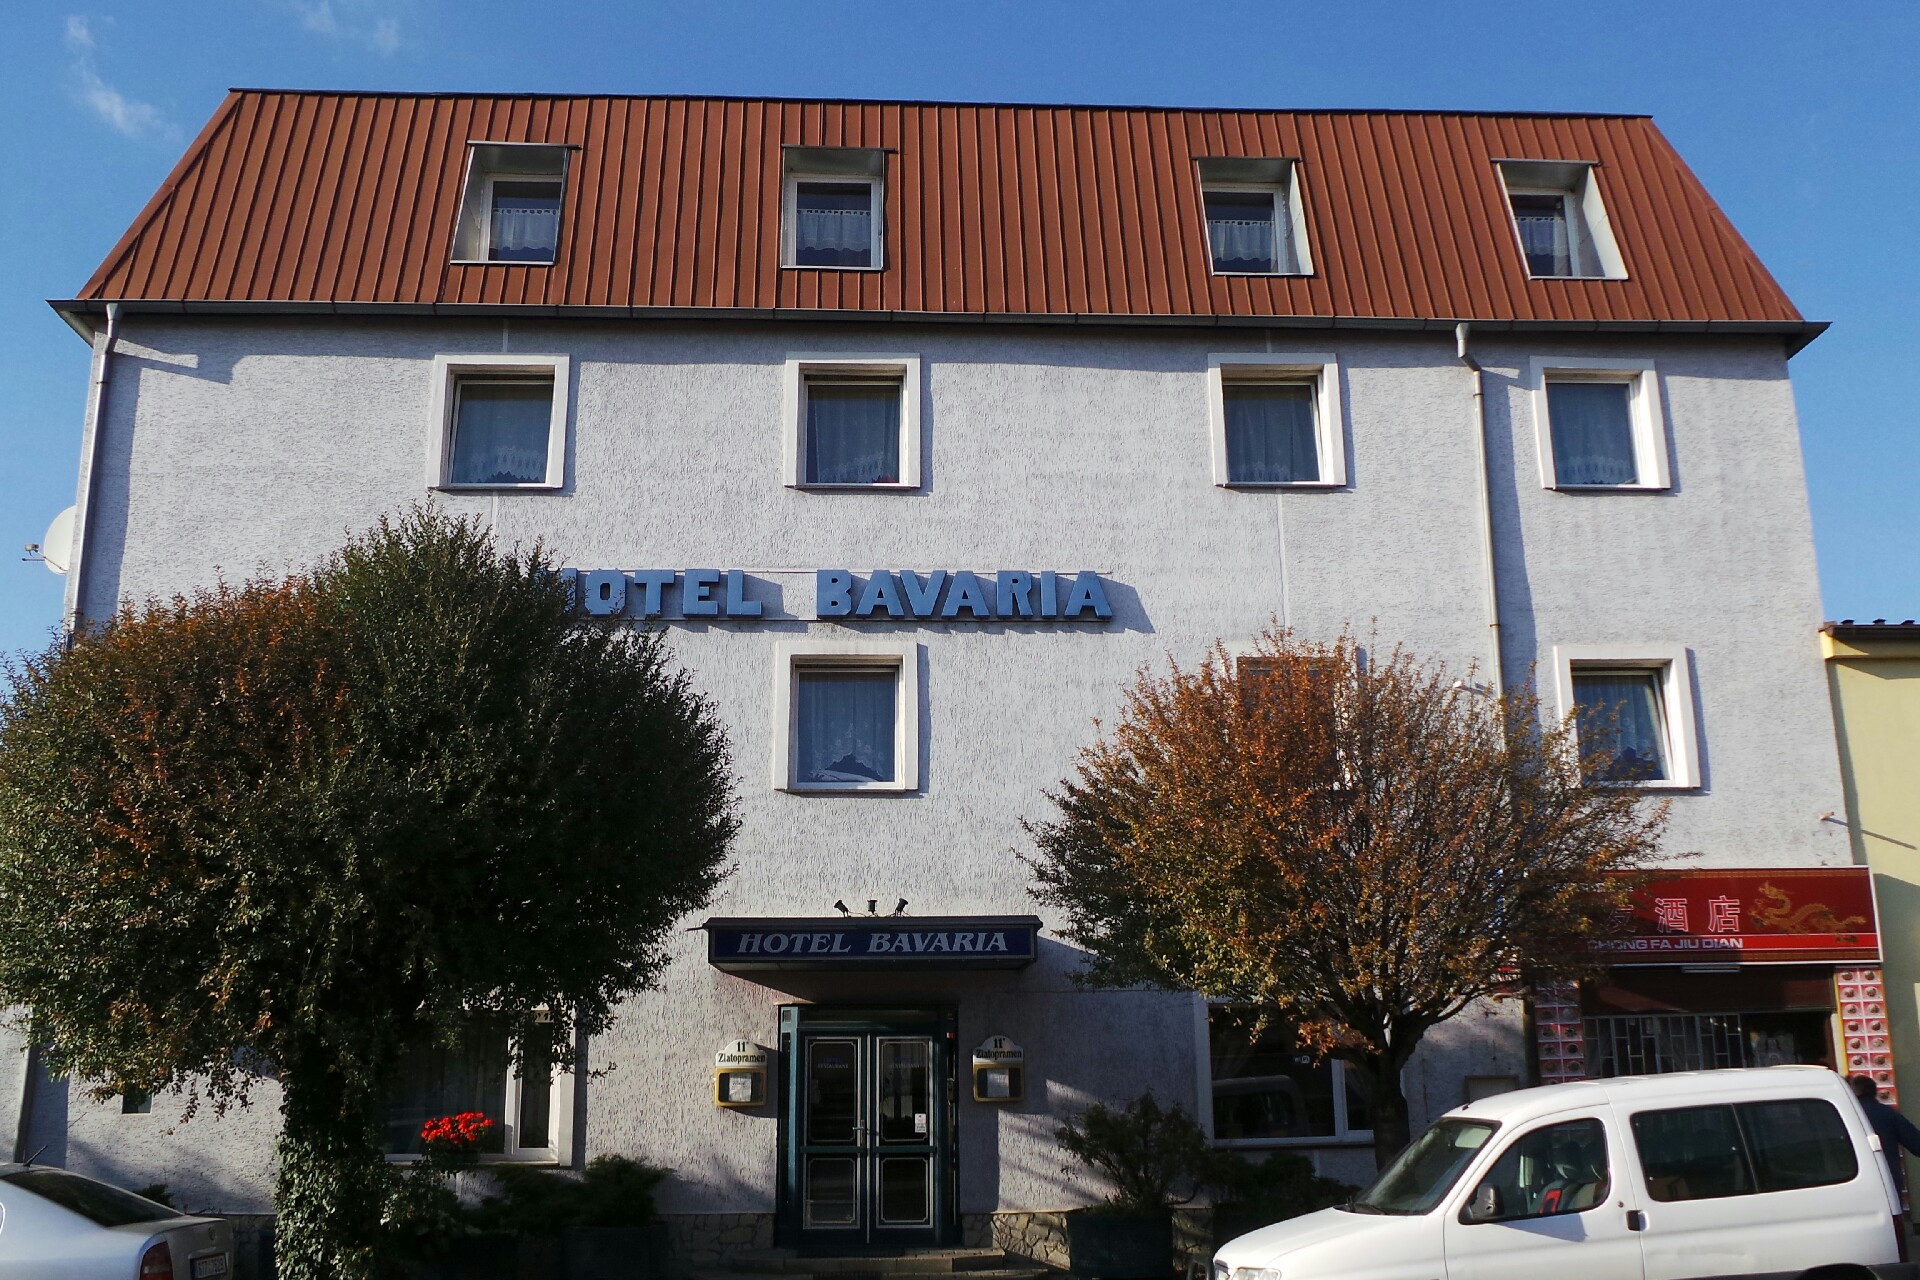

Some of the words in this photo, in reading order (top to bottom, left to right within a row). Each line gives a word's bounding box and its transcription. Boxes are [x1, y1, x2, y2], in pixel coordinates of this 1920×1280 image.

[816, 568, 1112, 619] BAVARIA
[737, 932, 853, 954] HOTEL
[867, 931, 1009, 953] BAVARIA
[1650, 938, 1670, 950] FA
[1674, 937, 1699, 949] JIU
[1702, 937, 1743, 949] DIAN
[718, 1053, 766, 1064] Zlatopramen
[976, 1049, 1022, 1060] Zlatopramen
